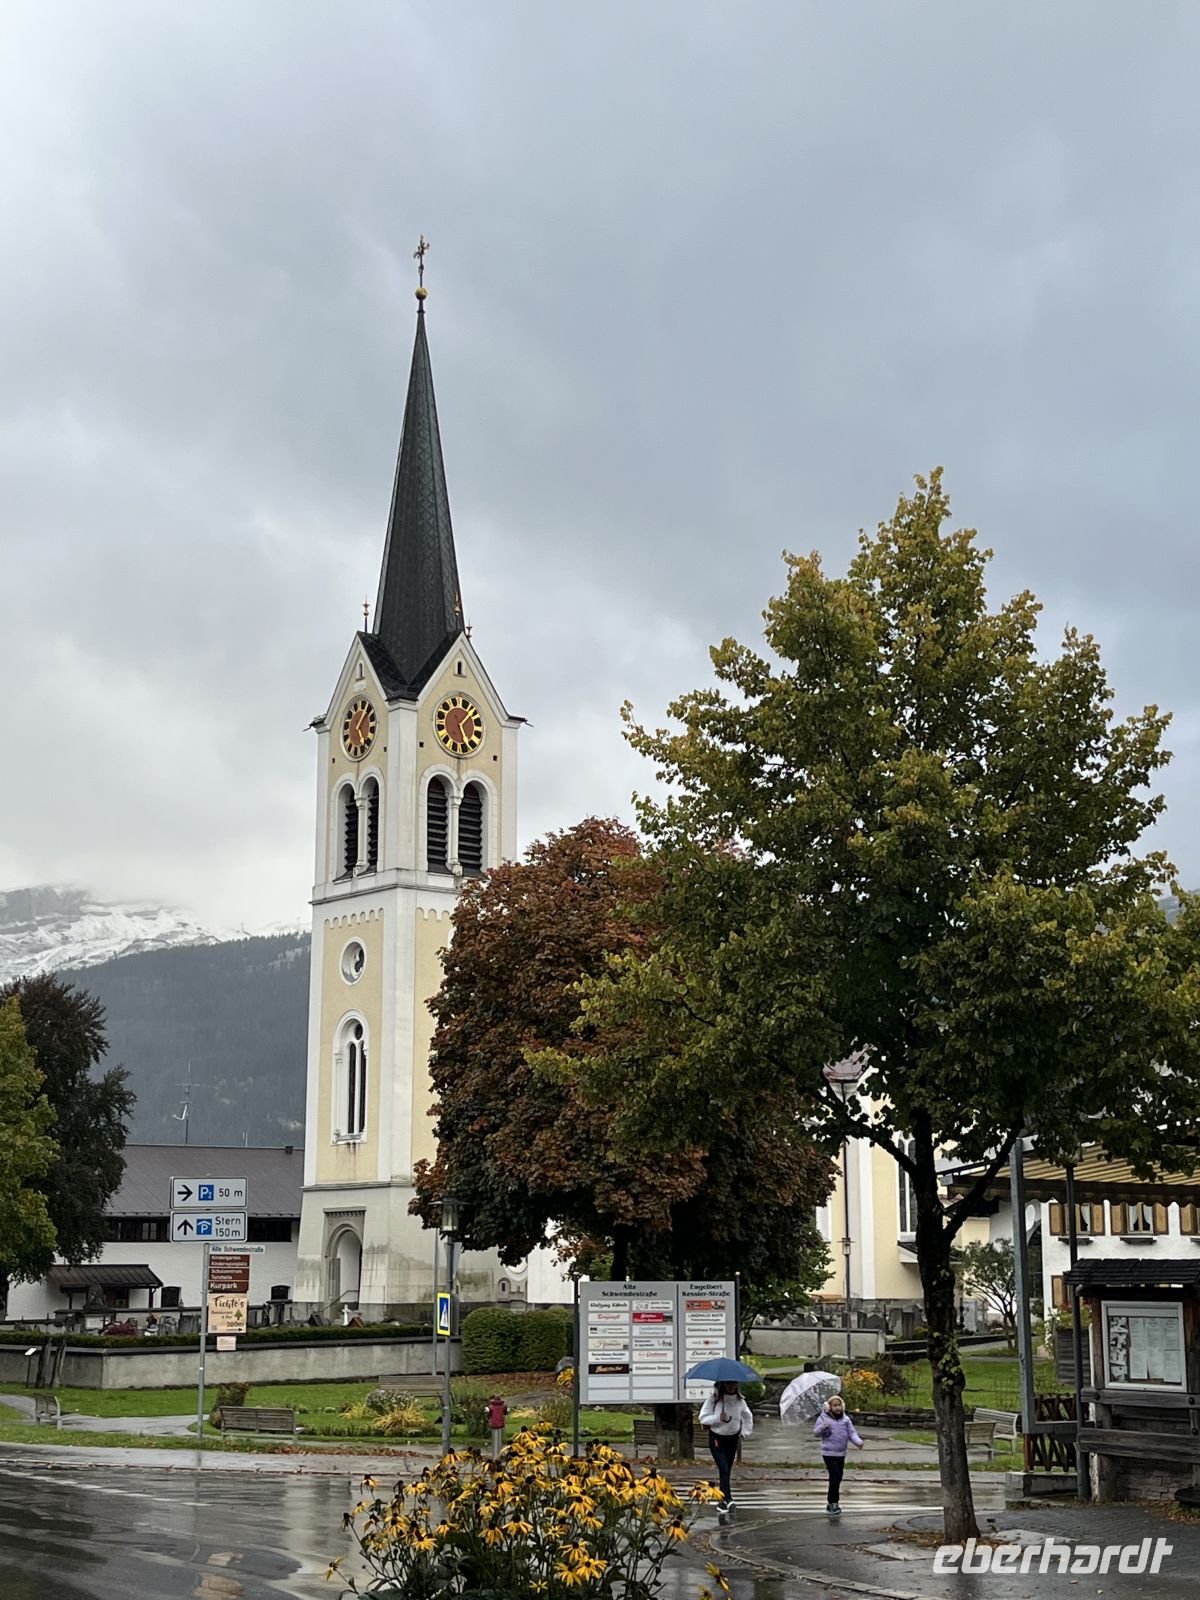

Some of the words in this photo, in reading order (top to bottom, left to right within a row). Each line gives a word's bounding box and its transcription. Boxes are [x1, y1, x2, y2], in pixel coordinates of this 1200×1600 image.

[218, 1188, 230, 1197] 50
[215, 1216, 241, 1225] Stern
[210, 1282, 238, 1290] Kurpark
